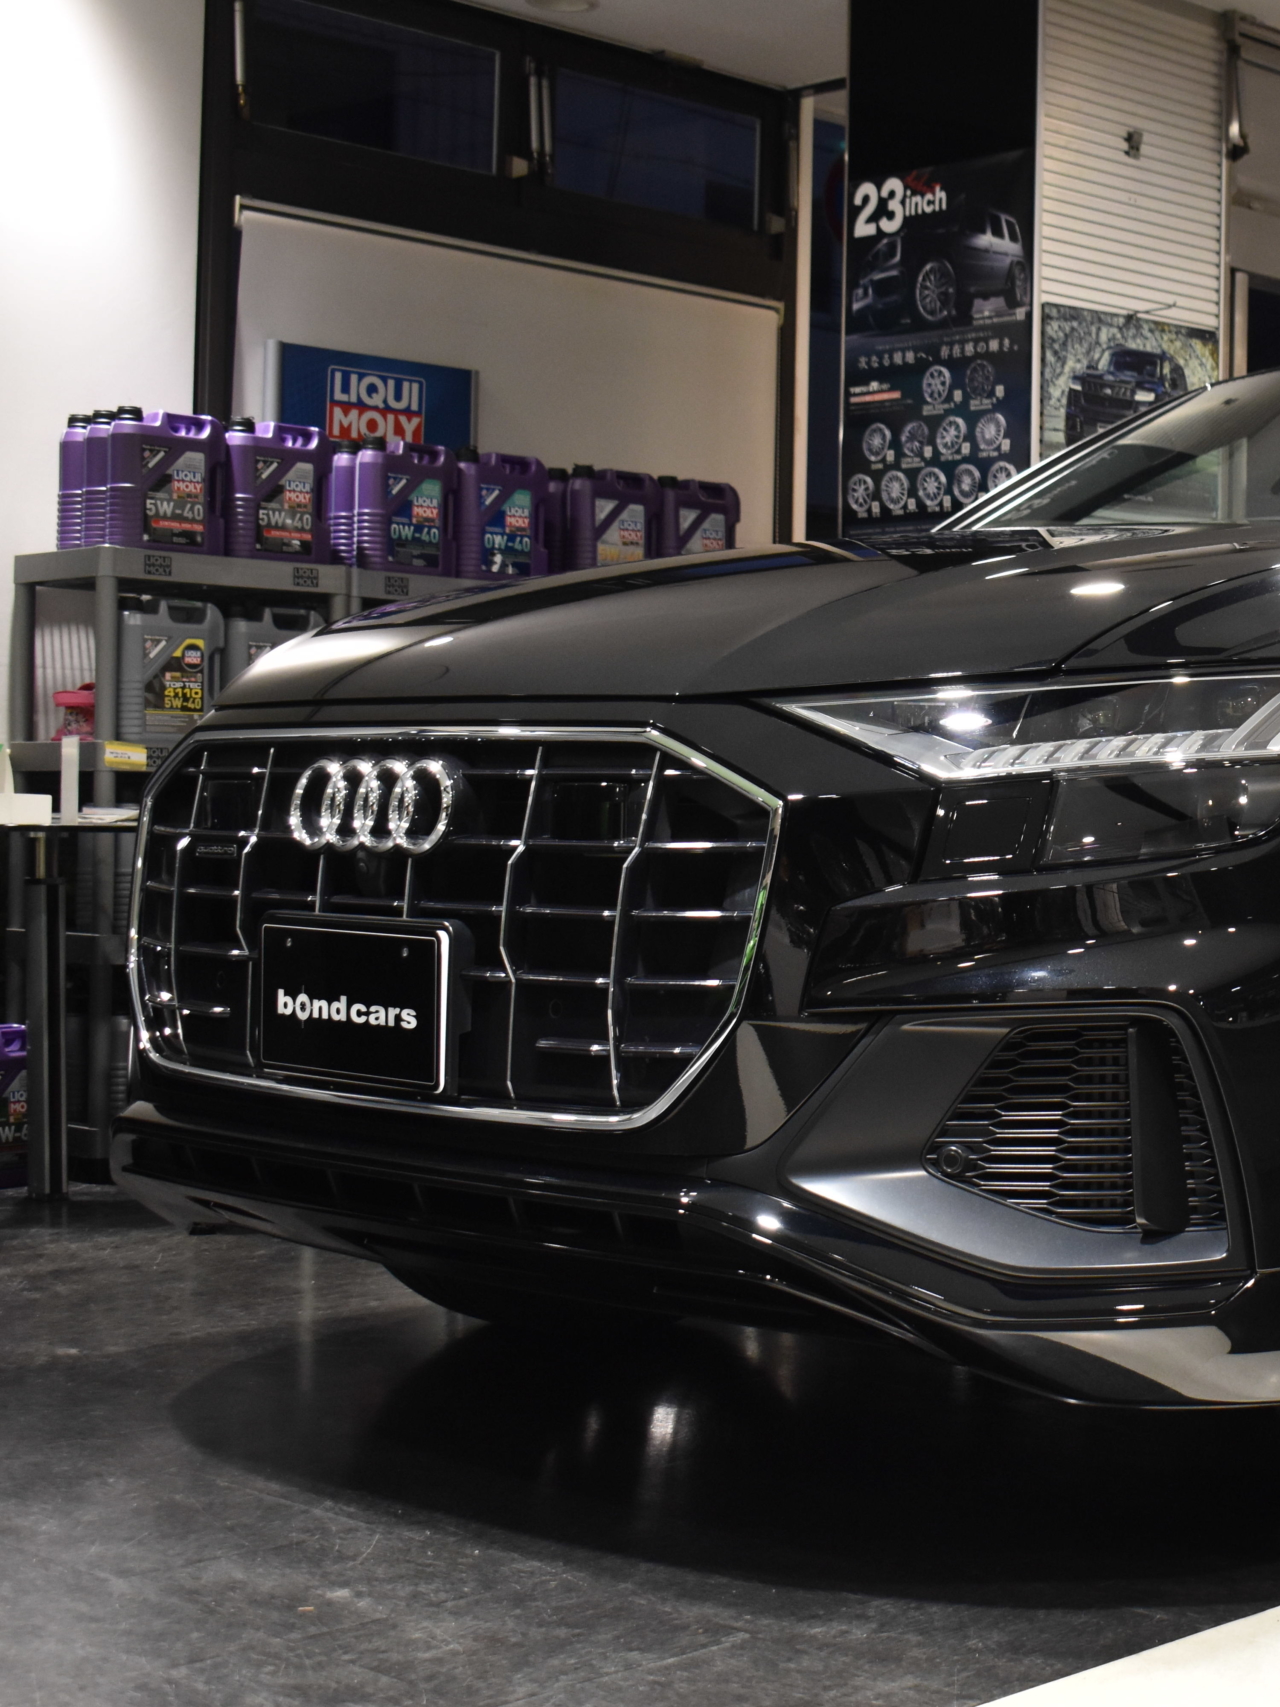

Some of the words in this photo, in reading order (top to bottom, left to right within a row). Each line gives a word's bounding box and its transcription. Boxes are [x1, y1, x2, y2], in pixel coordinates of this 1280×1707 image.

[333, 371, 419, 411] LIQUI
[332, 406, 422, 443] MOLY
[173, 470, 202, 482] LIQUI
[173, 481, 203, 493] MOLY
[285, 480, 311, 492] LIQUI
[285, 491, 311, 503] MOLY
[413, 496, 438, 508] LIQUI
[145, 499, 204, 520] 5W-40
[413, 506, 439, 518] MOLY
[506, 506, 529, 517] LIQUI
[258, 509, 312, 529] 5W-40
[506, 516, 530, 527] MOLY
[390, 524, 439, 543] 0W-40
[484, 533, 531, 551] 0W-40
[145, 555, 172, 567] LIQUI
[144, 565, 172, 576] MOLY
[294, 567, 318, 578] LIQUI
[294, 577, 319, 588] MOLY
[164, 688, 202, 698] 4110
[164, 697, 202, 709] 5W-40
[147, 748, 168, 758] IQUI
[196, 845, 235, 854] quattro
[10, 1090, 27, 1102] LIQ
[11, 1102, 28, 1113] MO
